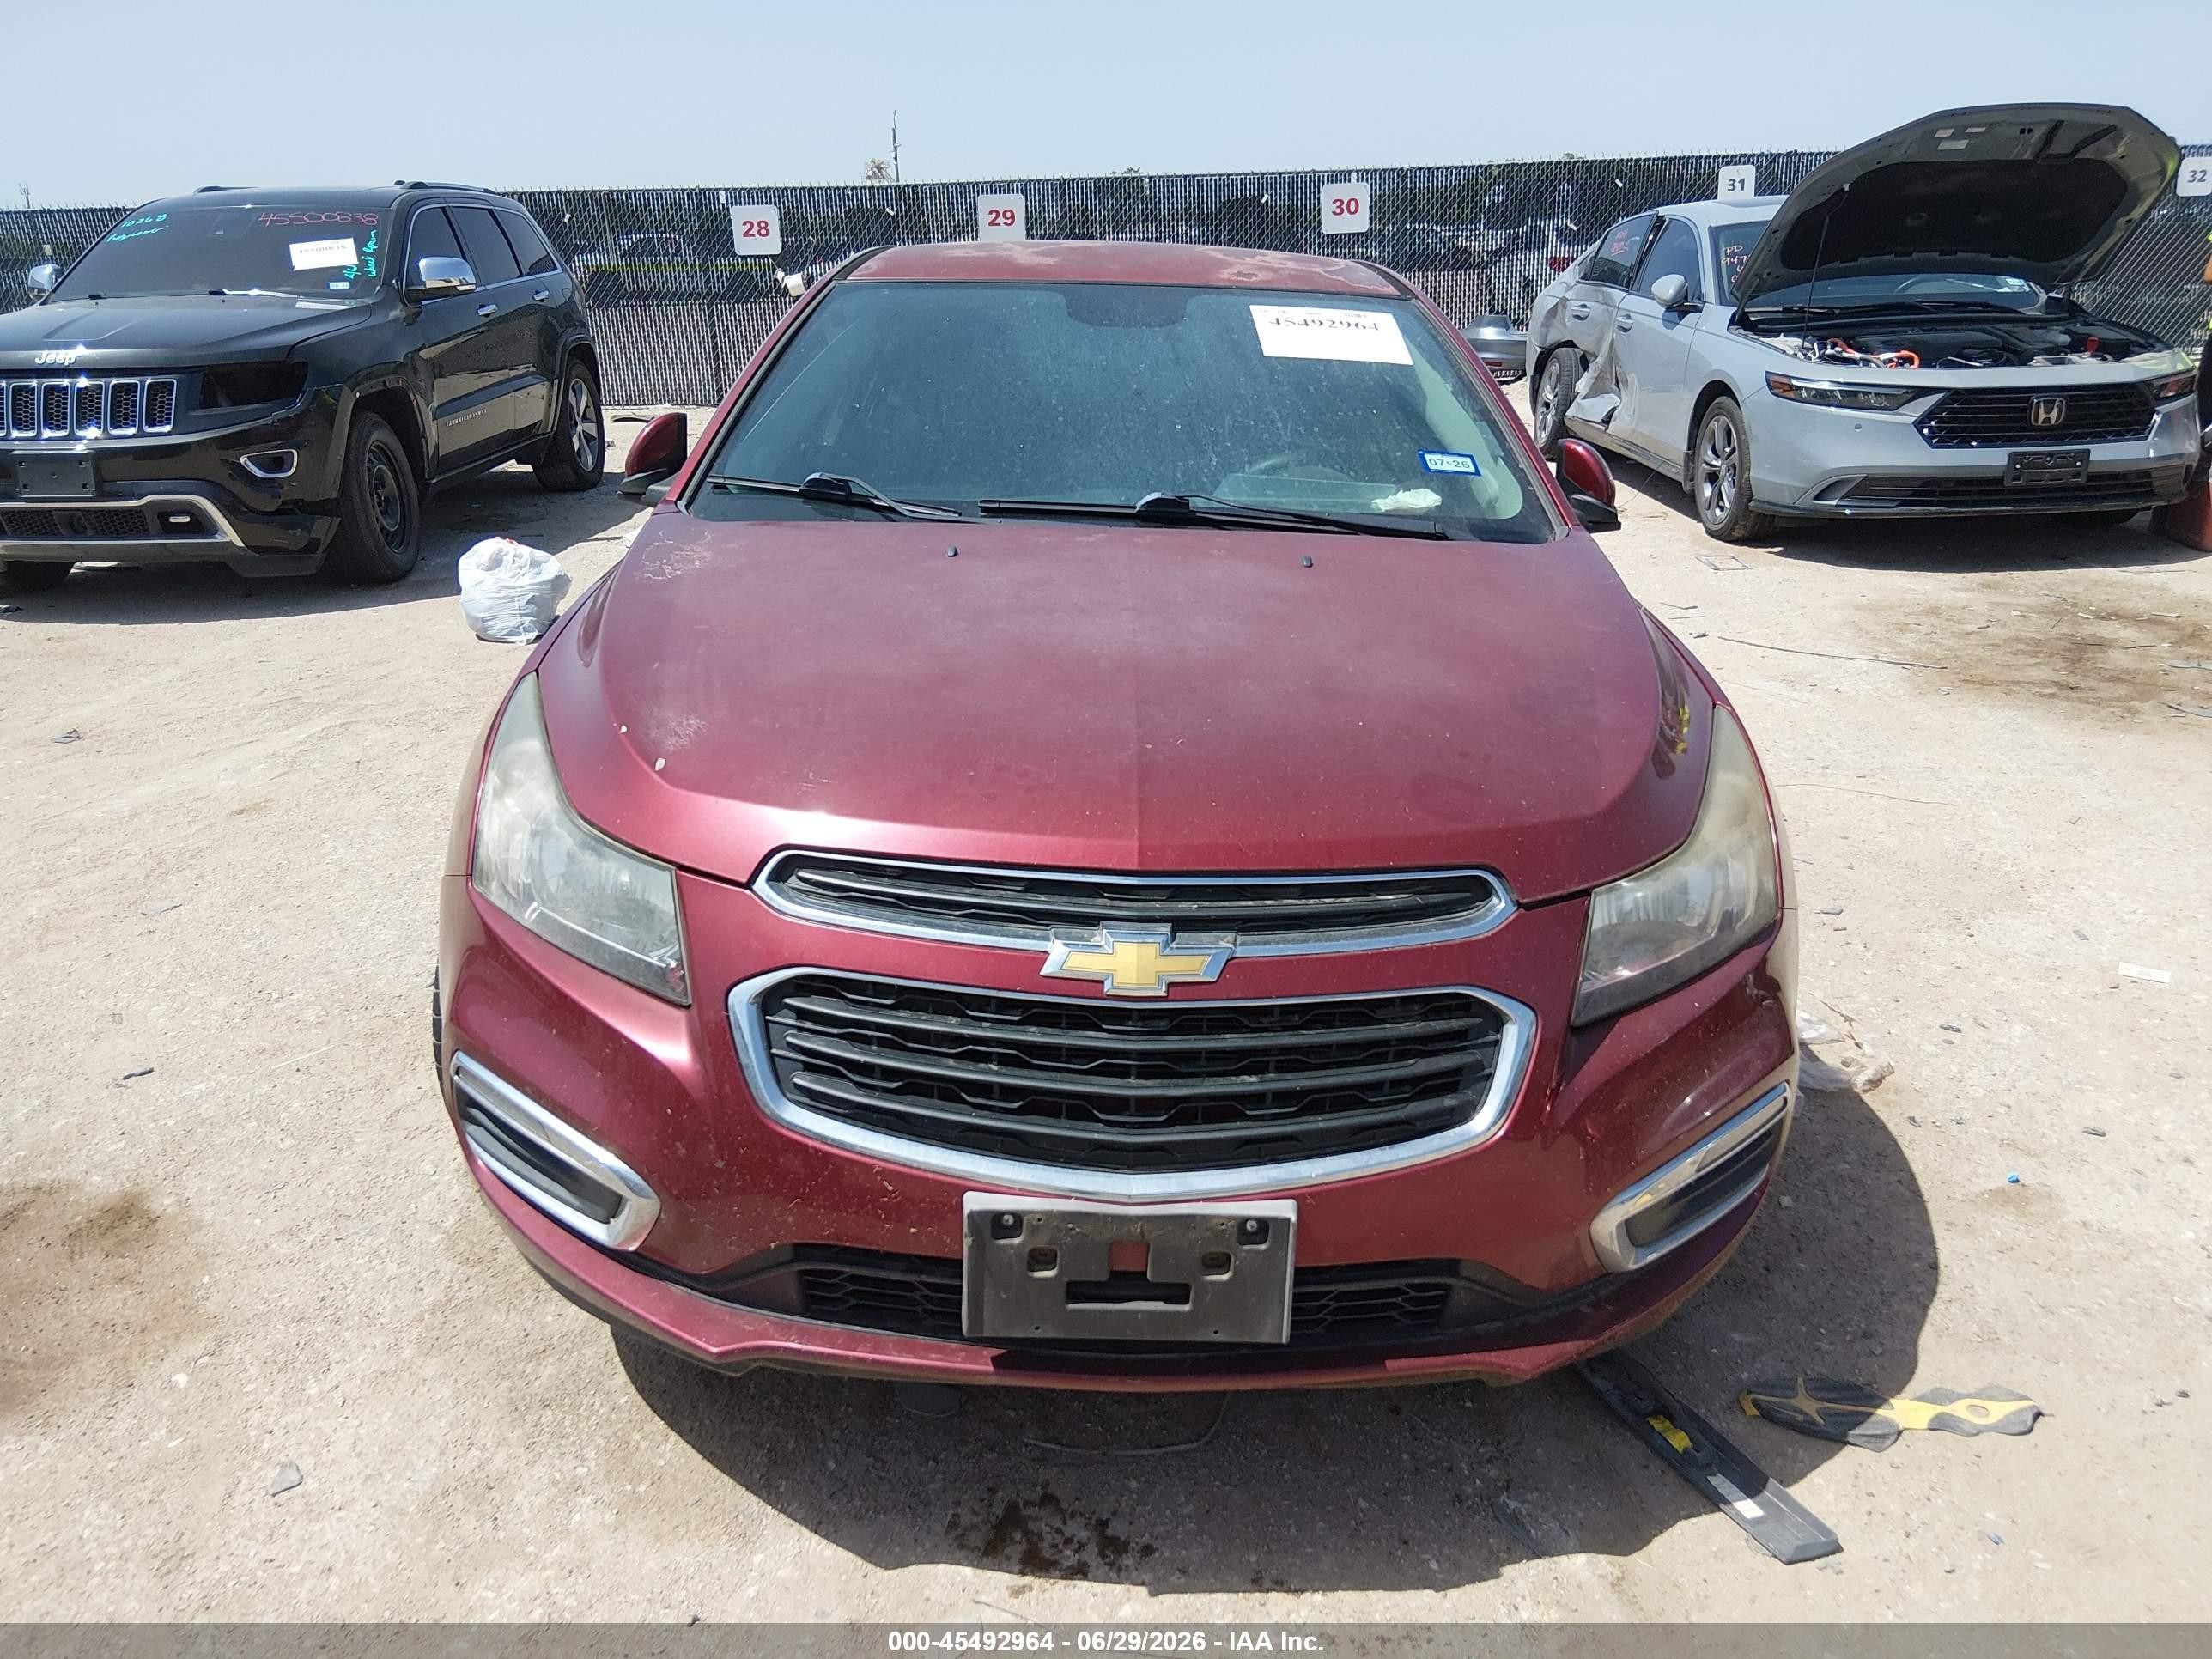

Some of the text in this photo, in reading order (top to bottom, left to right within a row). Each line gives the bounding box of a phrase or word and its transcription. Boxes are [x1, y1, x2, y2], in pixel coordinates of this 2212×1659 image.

[1728, 178, 1746, 191] 31
[2187, 170, 2207, 183] 32
[1332, 198, 1359, 216] 30
[258, 211, 379, 227] 45500838
[988, 209, 1016, 227] 29
[742, 220, 770, 238] 28
[1269, 317, 1379, 331] 45492964
[34, 350, 76, 366] Jeep
